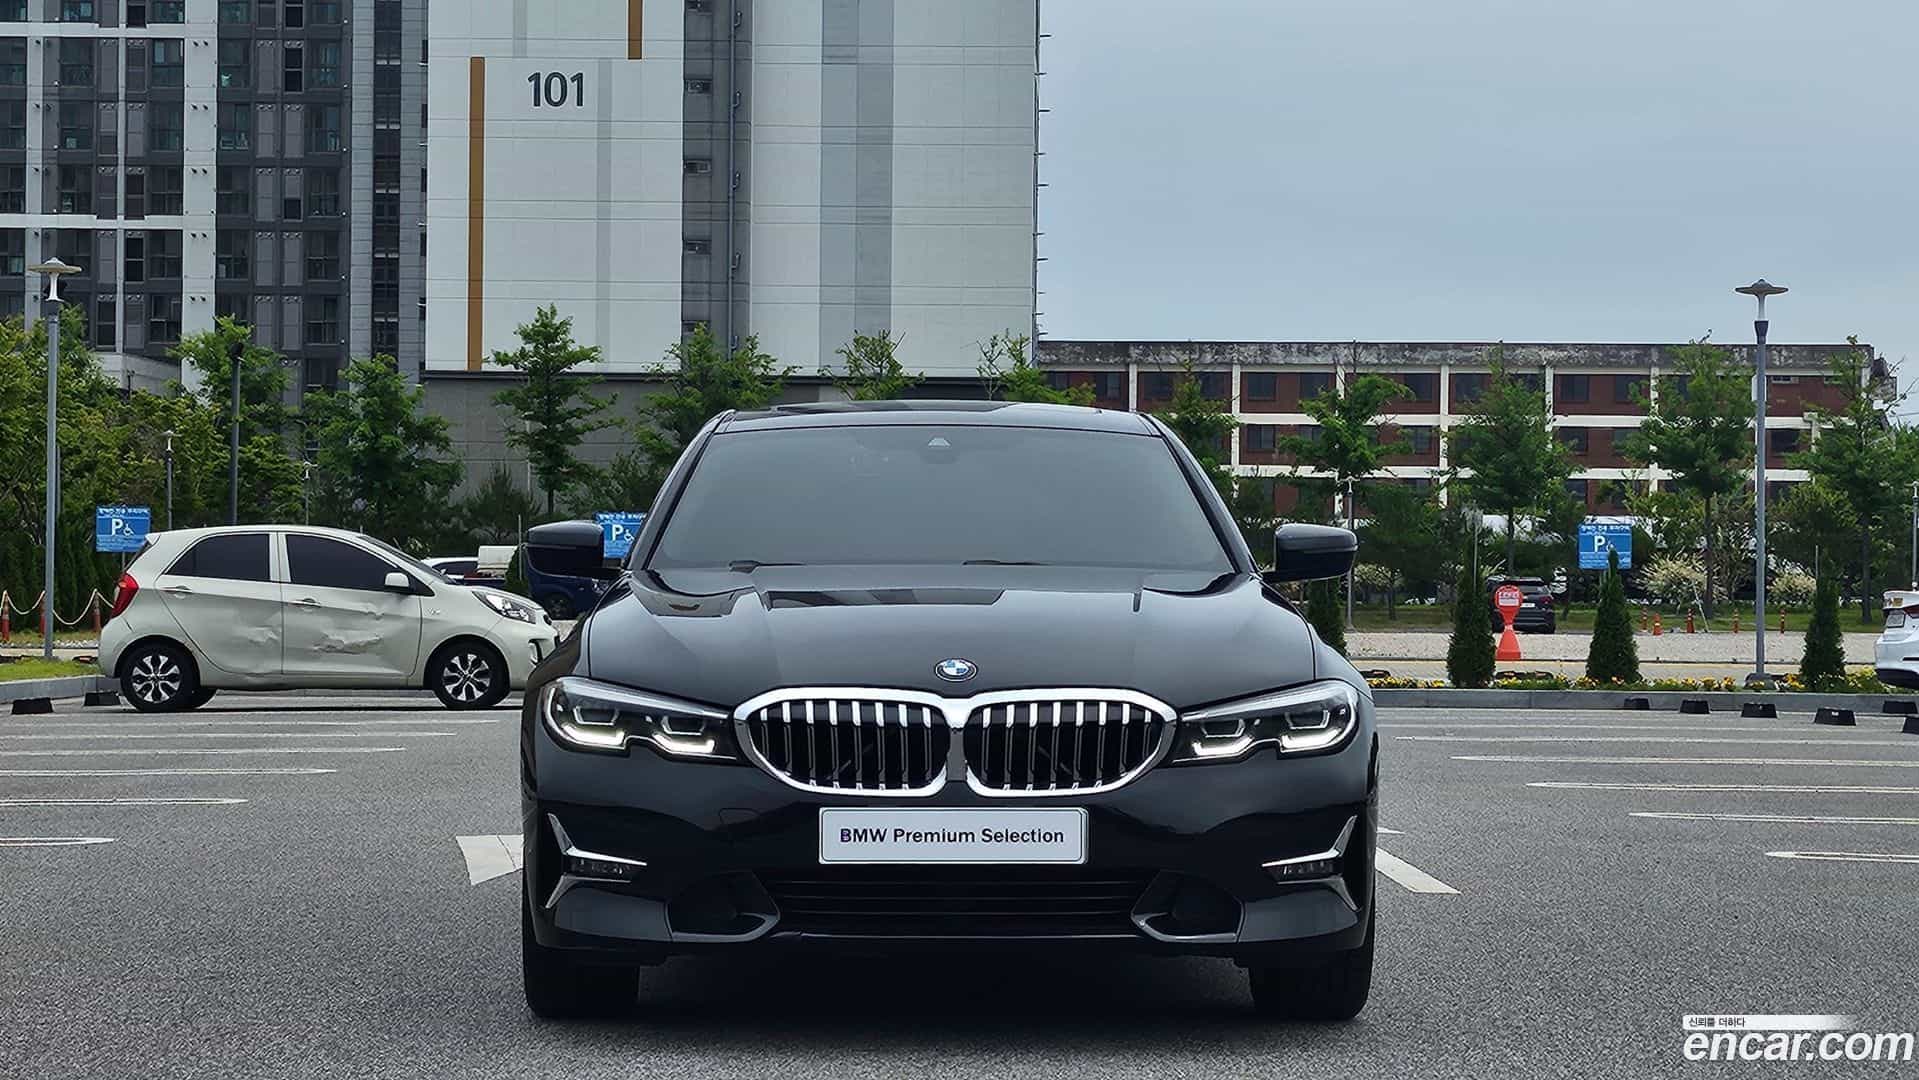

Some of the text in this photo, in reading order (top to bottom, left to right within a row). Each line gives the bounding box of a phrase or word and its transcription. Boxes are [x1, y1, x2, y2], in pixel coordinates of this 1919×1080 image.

[527, 71, 584, 107] 101
[111, 518, 124, 536] P
[611, 524, 624, 542] P
[1594, 535, 1606, 552] P
[840, 828, 1065, 843] BMW Premium Selection
